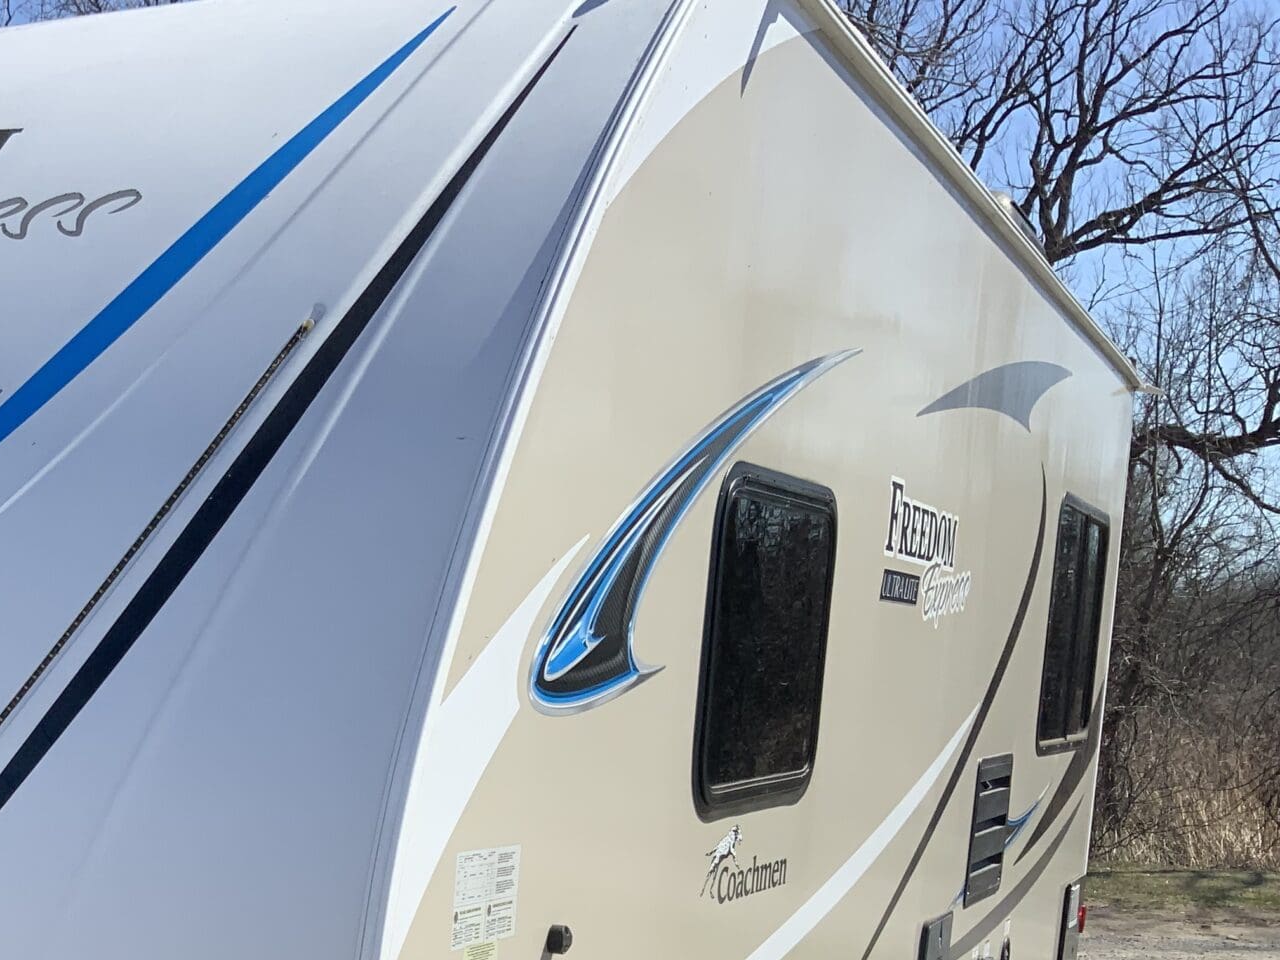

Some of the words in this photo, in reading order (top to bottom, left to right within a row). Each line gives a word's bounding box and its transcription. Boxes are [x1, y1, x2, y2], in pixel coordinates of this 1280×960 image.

[885, 480, 958, 568] FREEDOM
[922, 562, 970, 625] Express
[717, 855, 787, 905] Coachmen
